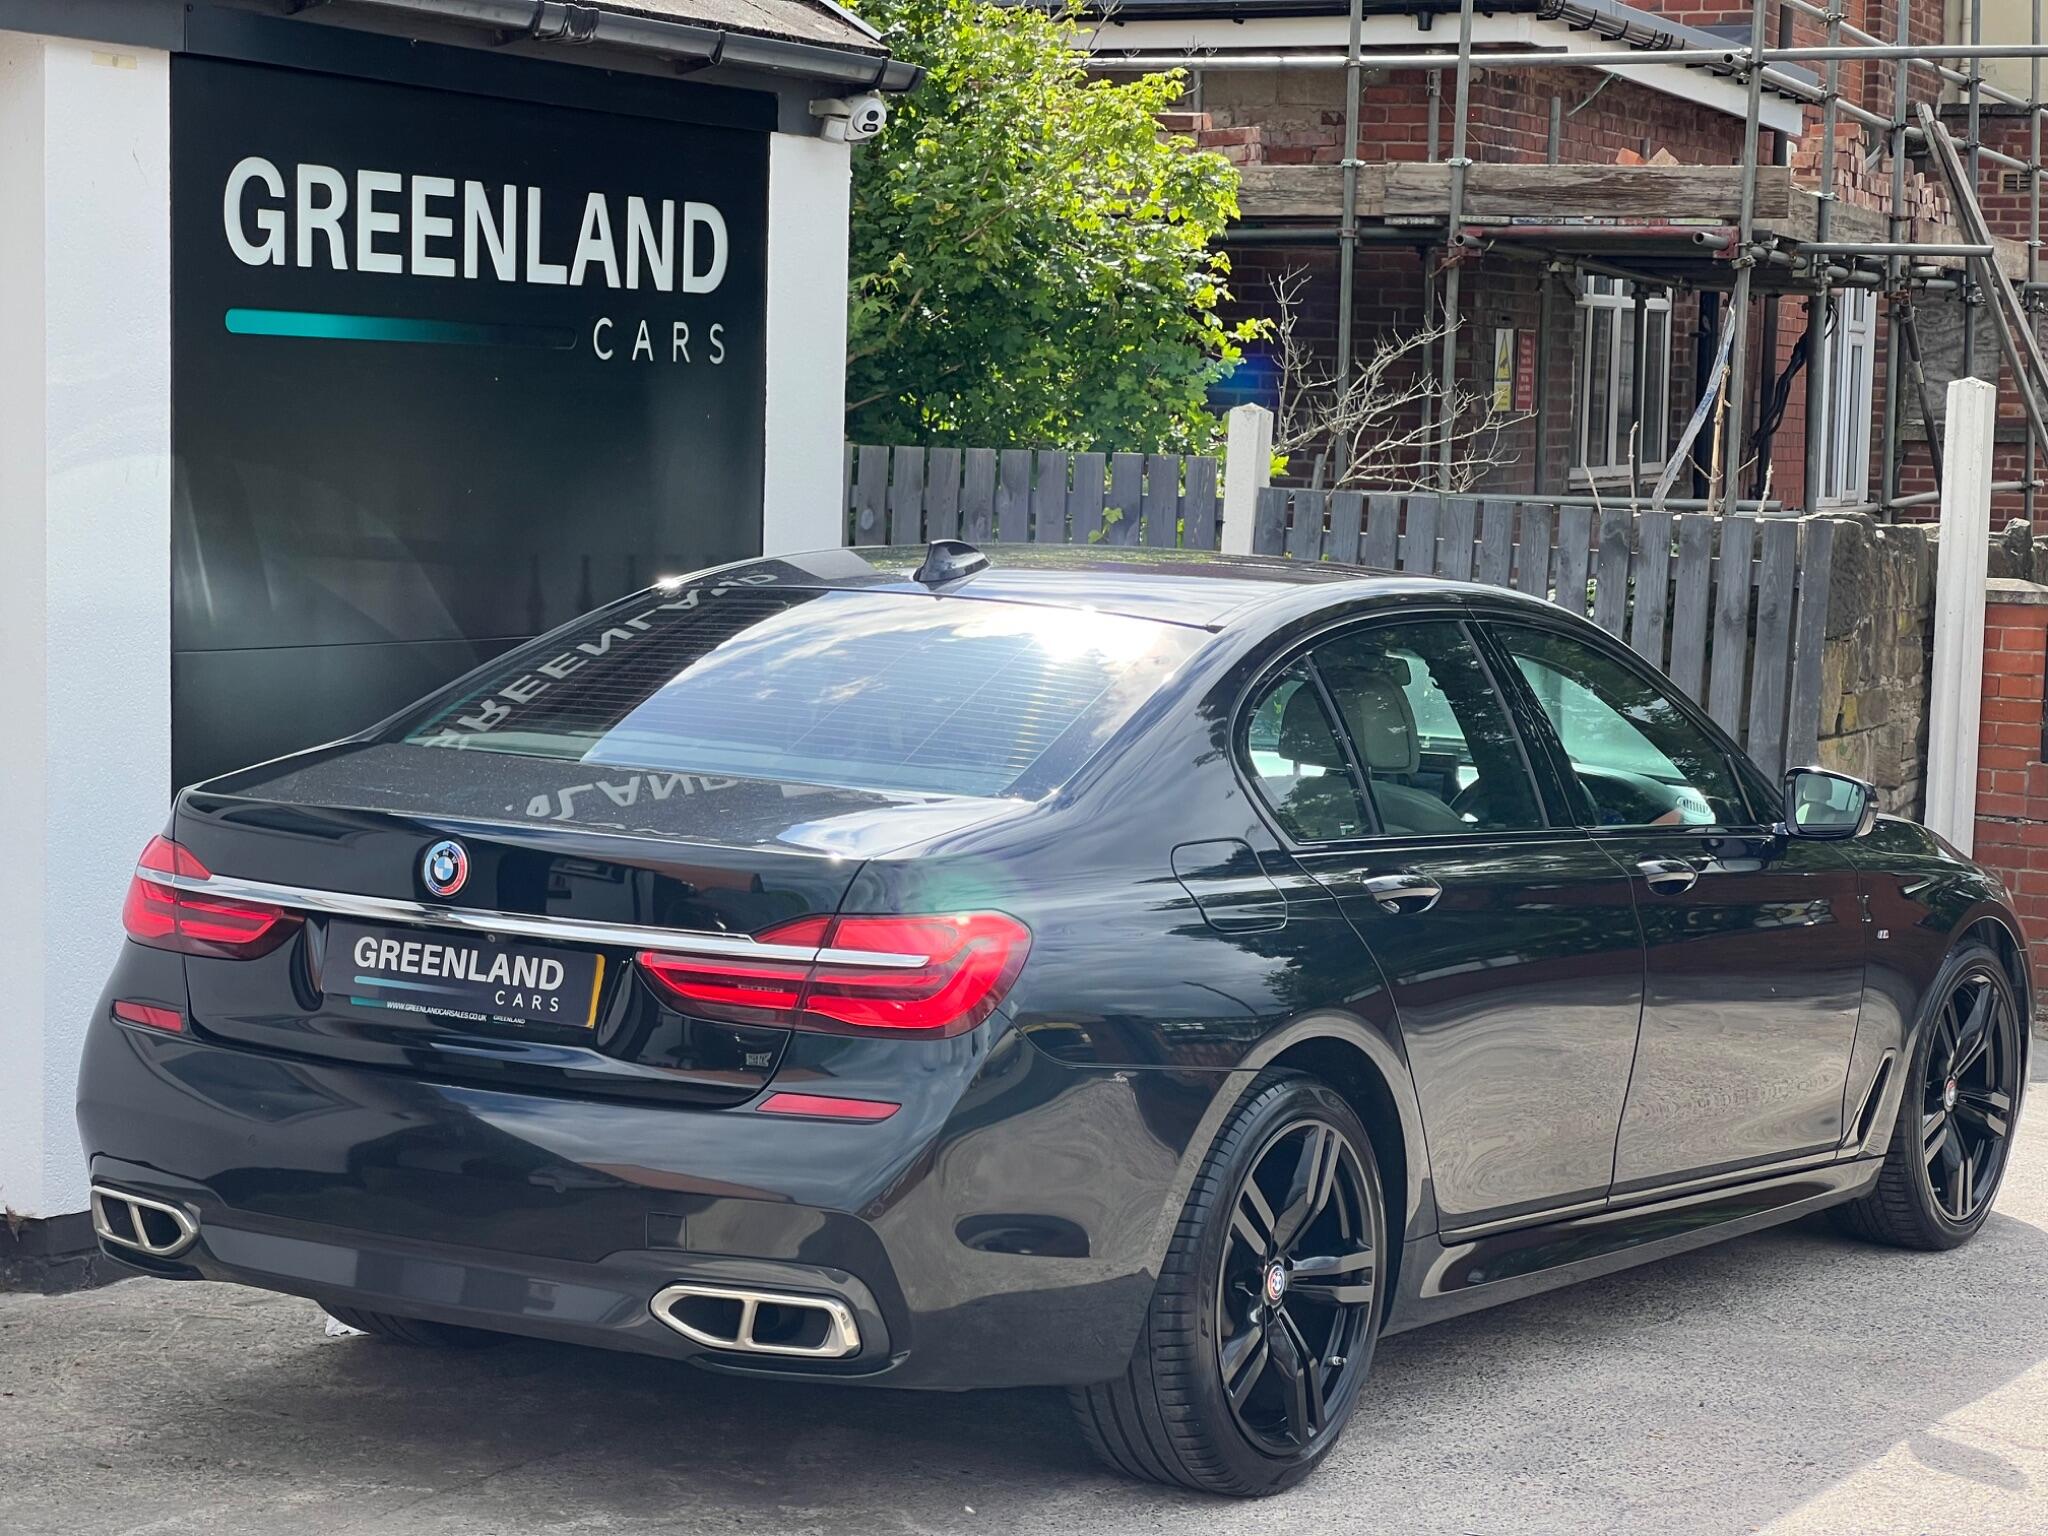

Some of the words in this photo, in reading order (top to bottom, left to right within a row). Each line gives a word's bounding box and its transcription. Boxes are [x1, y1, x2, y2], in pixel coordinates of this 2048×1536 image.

[223, 156, 729, 294] GREENLAND
[593, 317, 725, 365] CARS
[353, 936, 565, 991] GREENLAND
[494, 990, 560, 1012] CARS
